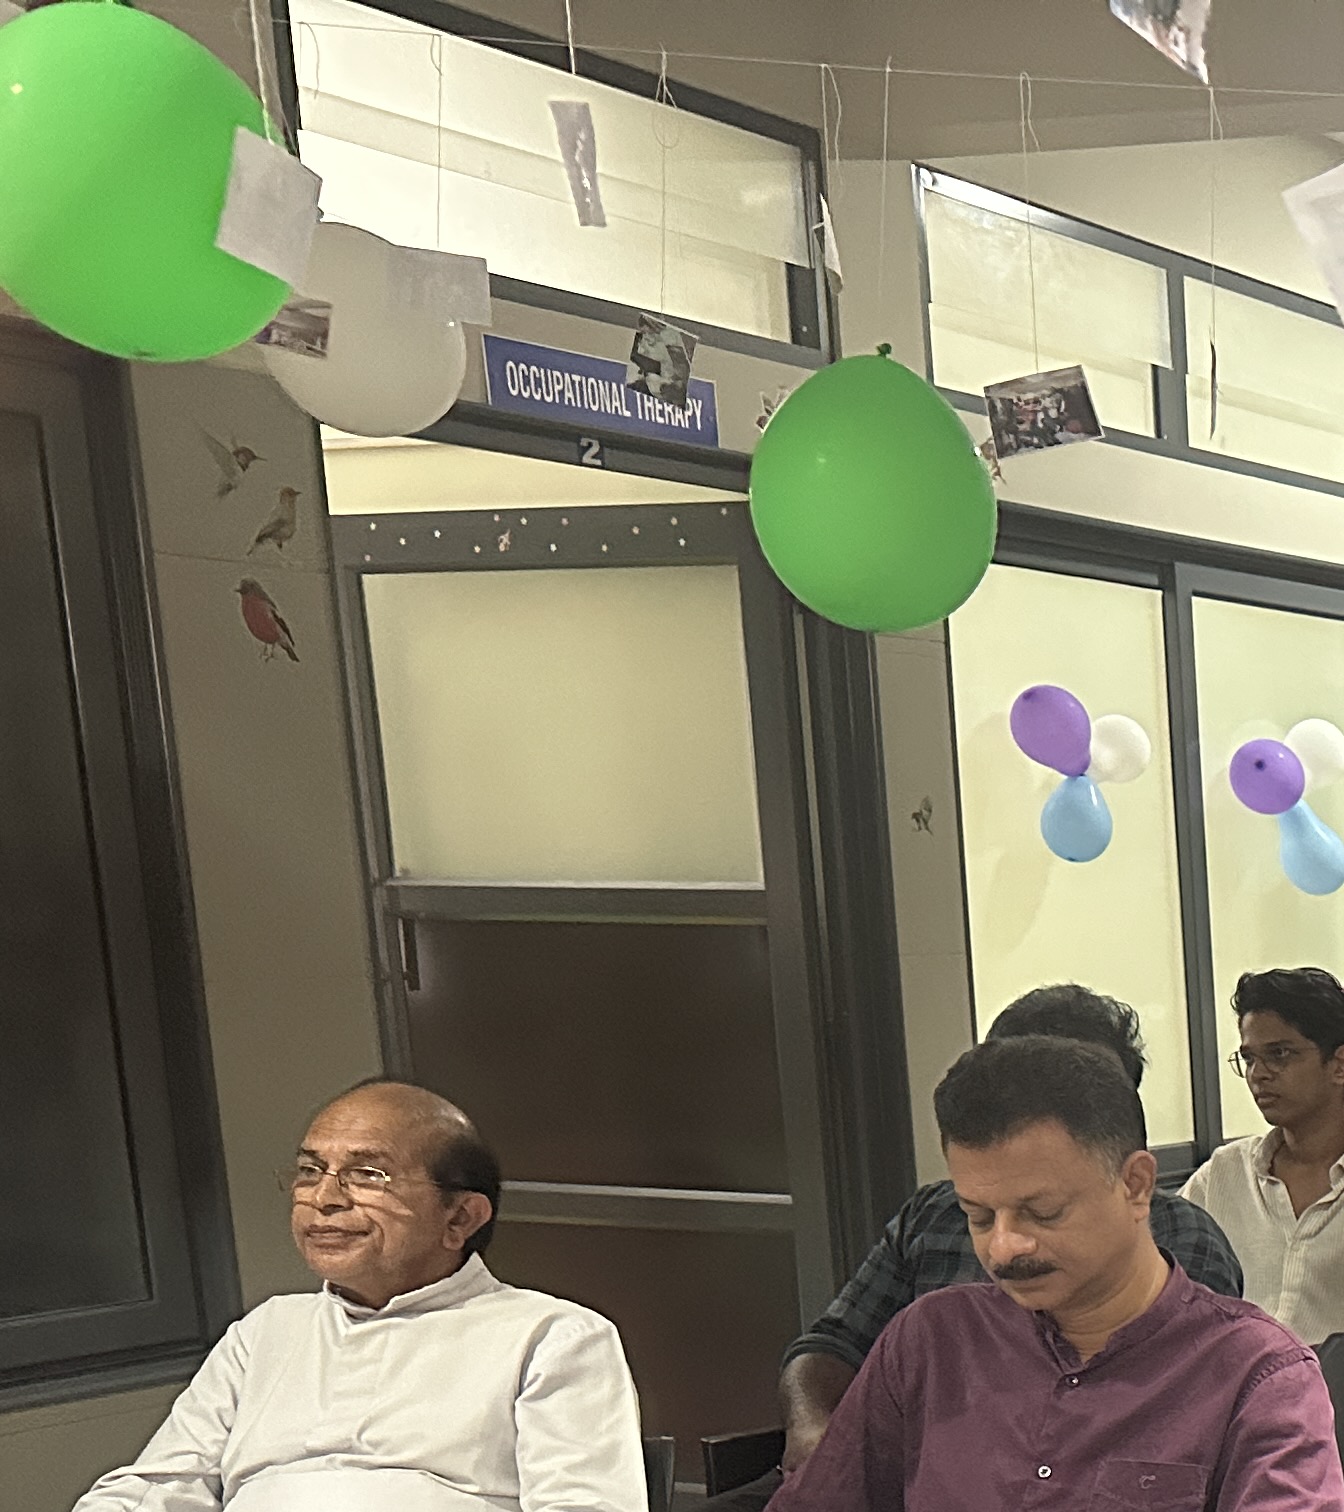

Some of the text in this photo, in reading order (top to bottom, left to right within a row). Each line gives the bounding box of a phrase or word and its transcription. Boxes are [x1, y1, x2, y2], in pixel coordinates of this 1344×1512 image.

[505, 360, 703, 431] OCCUPATIONAL THERAPY
[579, 437, 602, 466] 2
